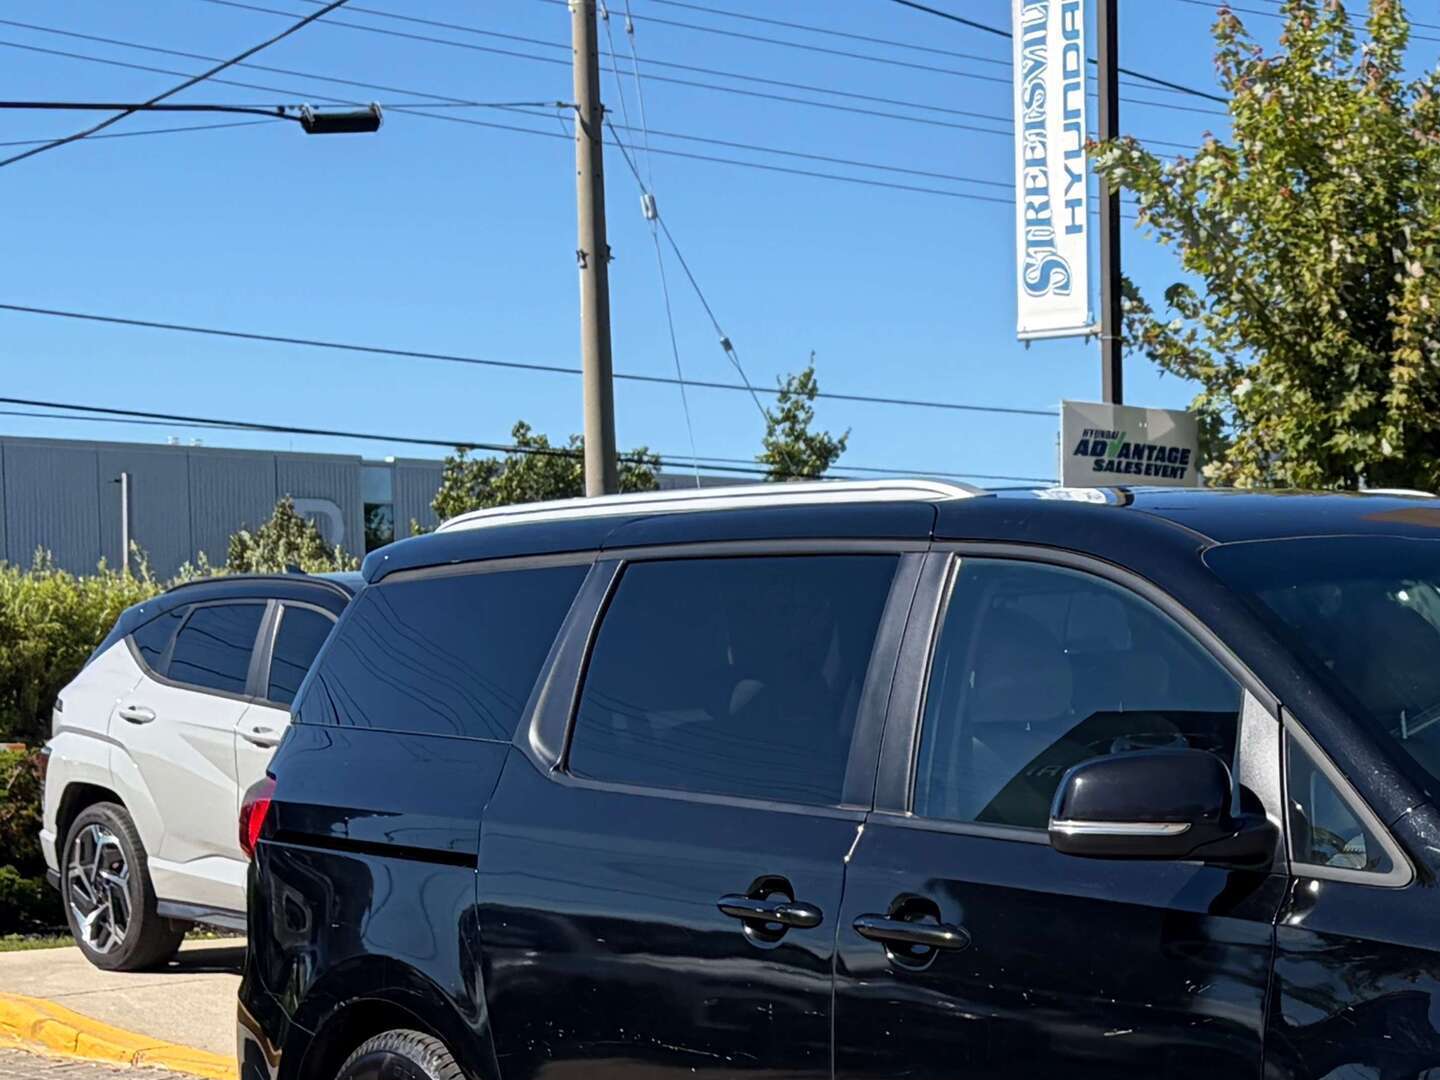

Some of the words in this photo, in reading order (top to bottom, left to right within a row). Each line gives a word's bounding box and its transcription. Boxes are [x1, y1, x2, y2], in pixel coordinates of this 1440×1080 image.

[1073, 432, 1192, 466] ADVANTAGE
[1092, 459, 1143, 475] SALES
[1143, 463, 1188, 480] EVENT
